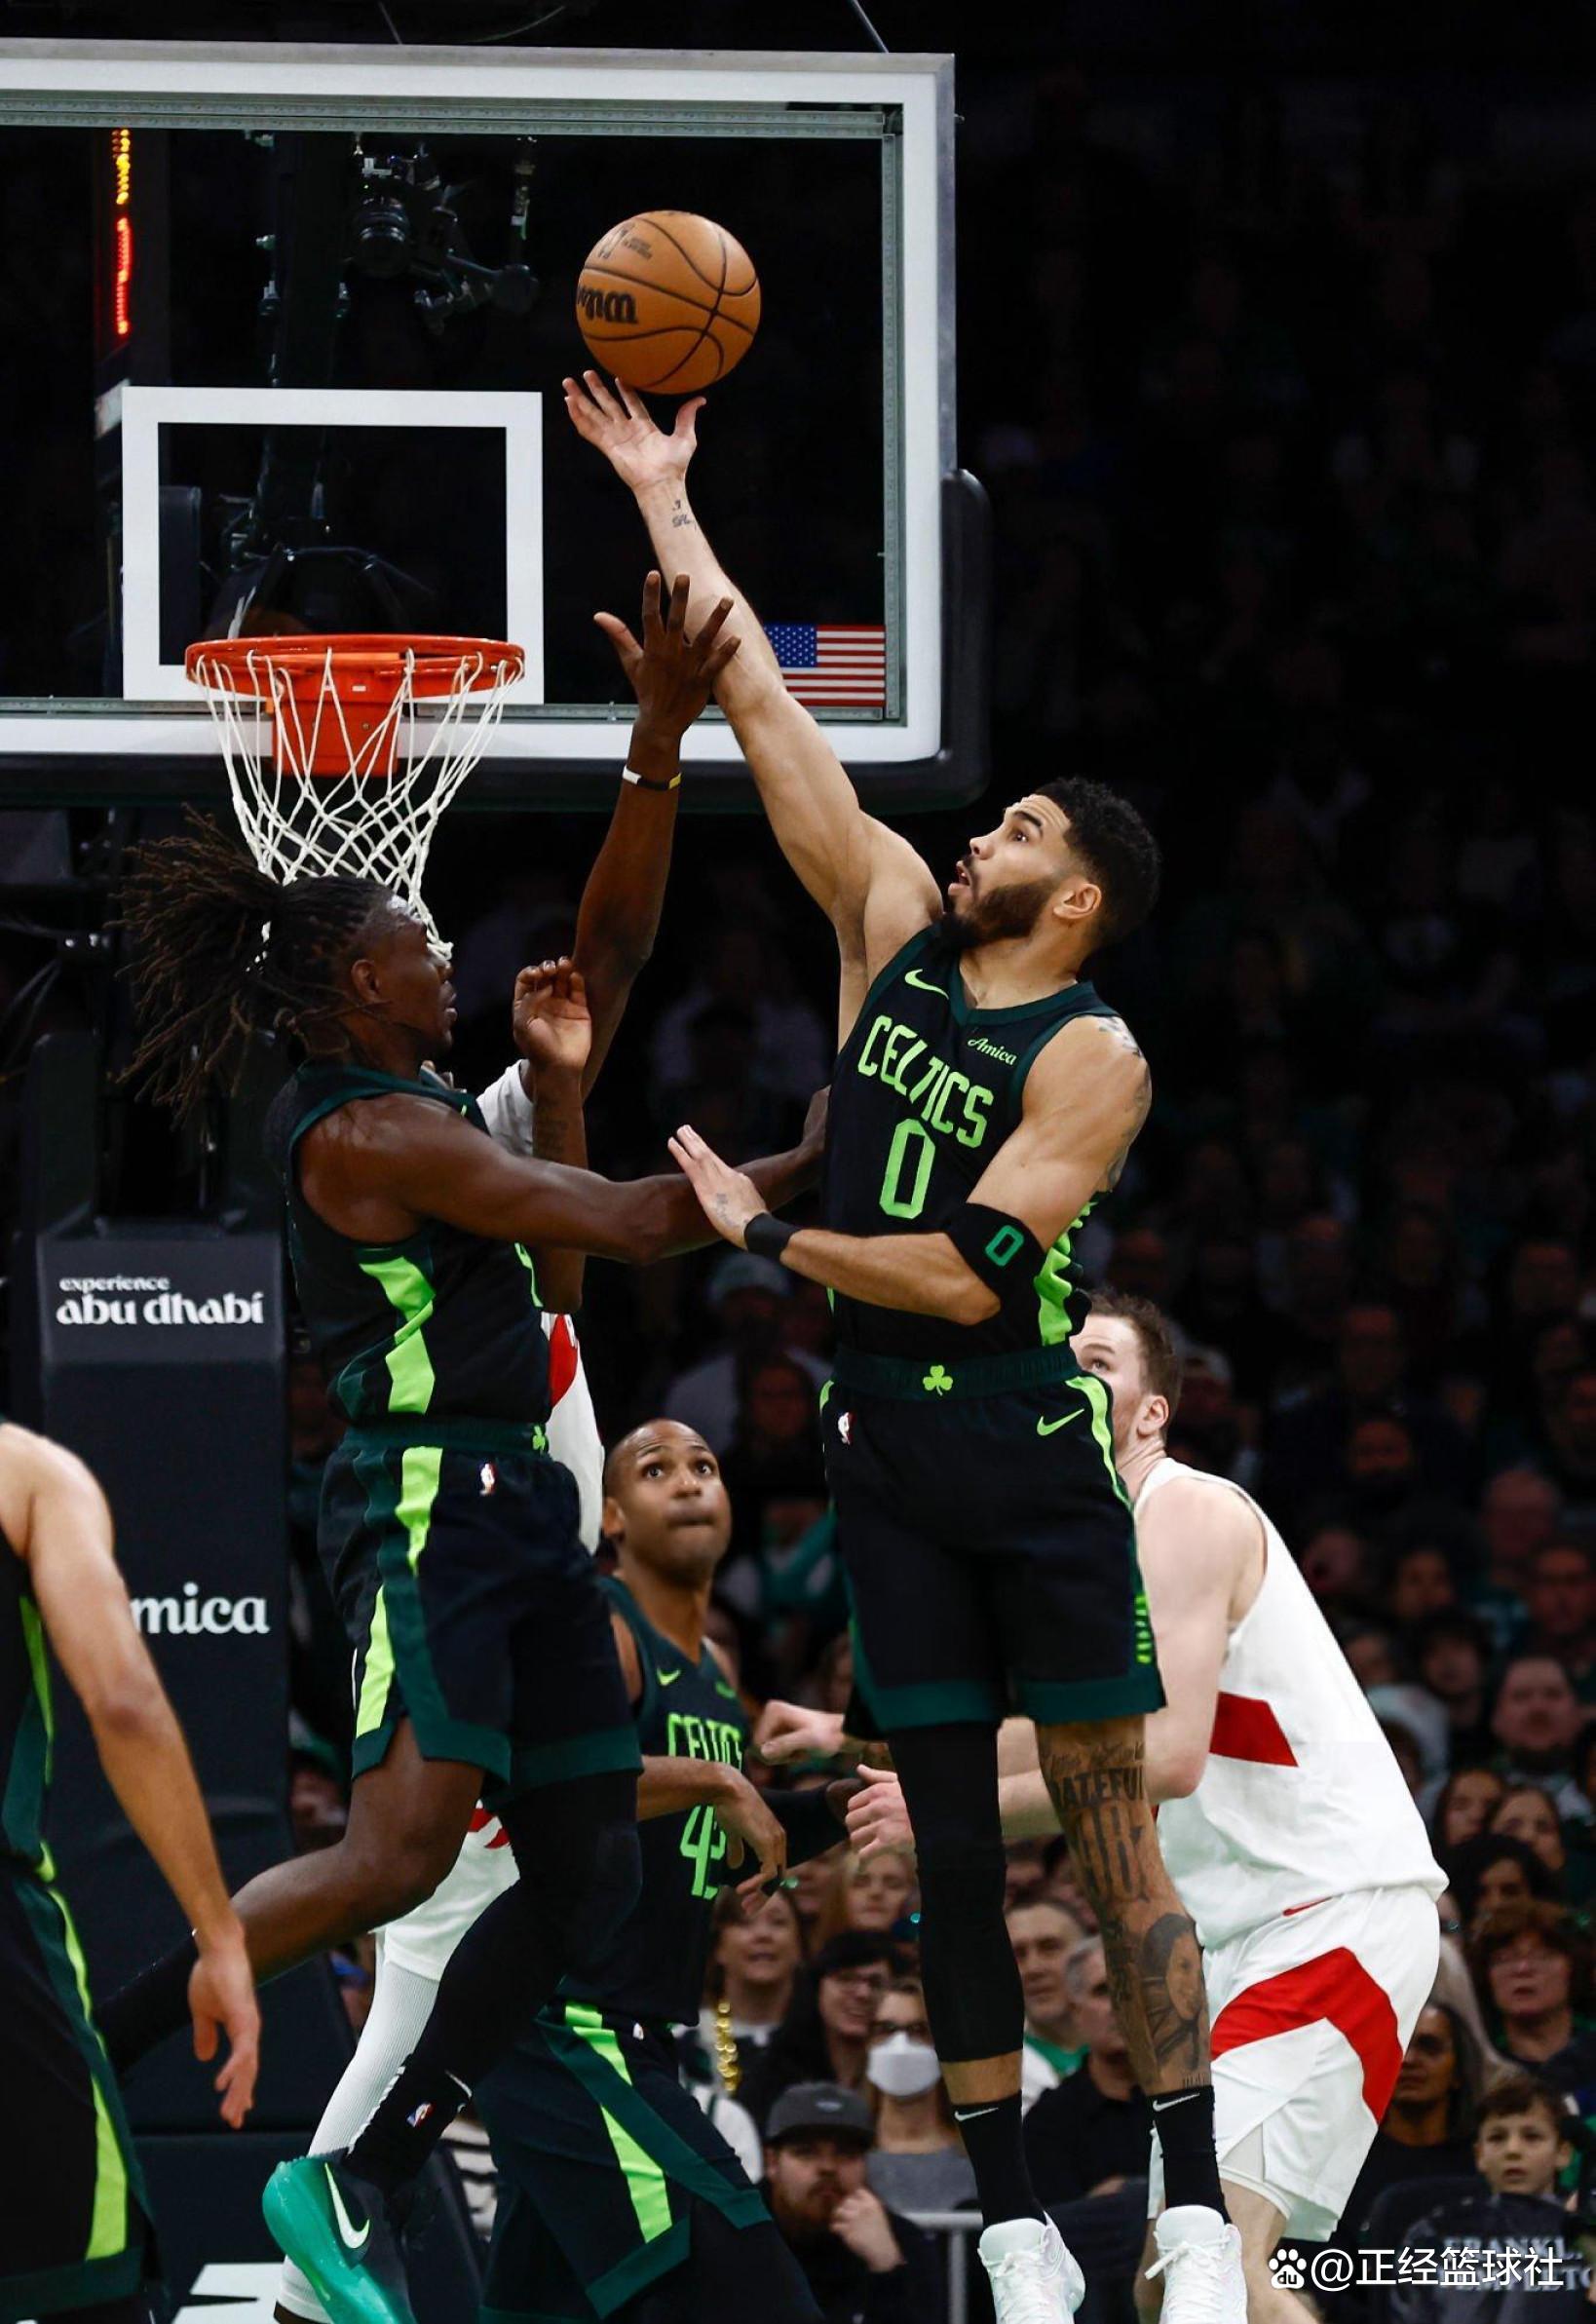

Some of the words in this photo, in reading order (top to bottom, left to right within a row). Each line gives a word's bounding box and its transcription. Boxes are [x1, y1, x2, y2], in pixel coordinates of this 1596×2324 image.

[967, 1037, 1018, 1066] Amica
[857, 1014, 995, 1149] CELTICS
[879, 1118, 936, 1220] 0
[984, 1225, 1025, 1267] 0
[58, 1274, 171, 1294] experience
[56, 1292, 138, 1325] abu
[130, 1581, 272, 1635] mica
